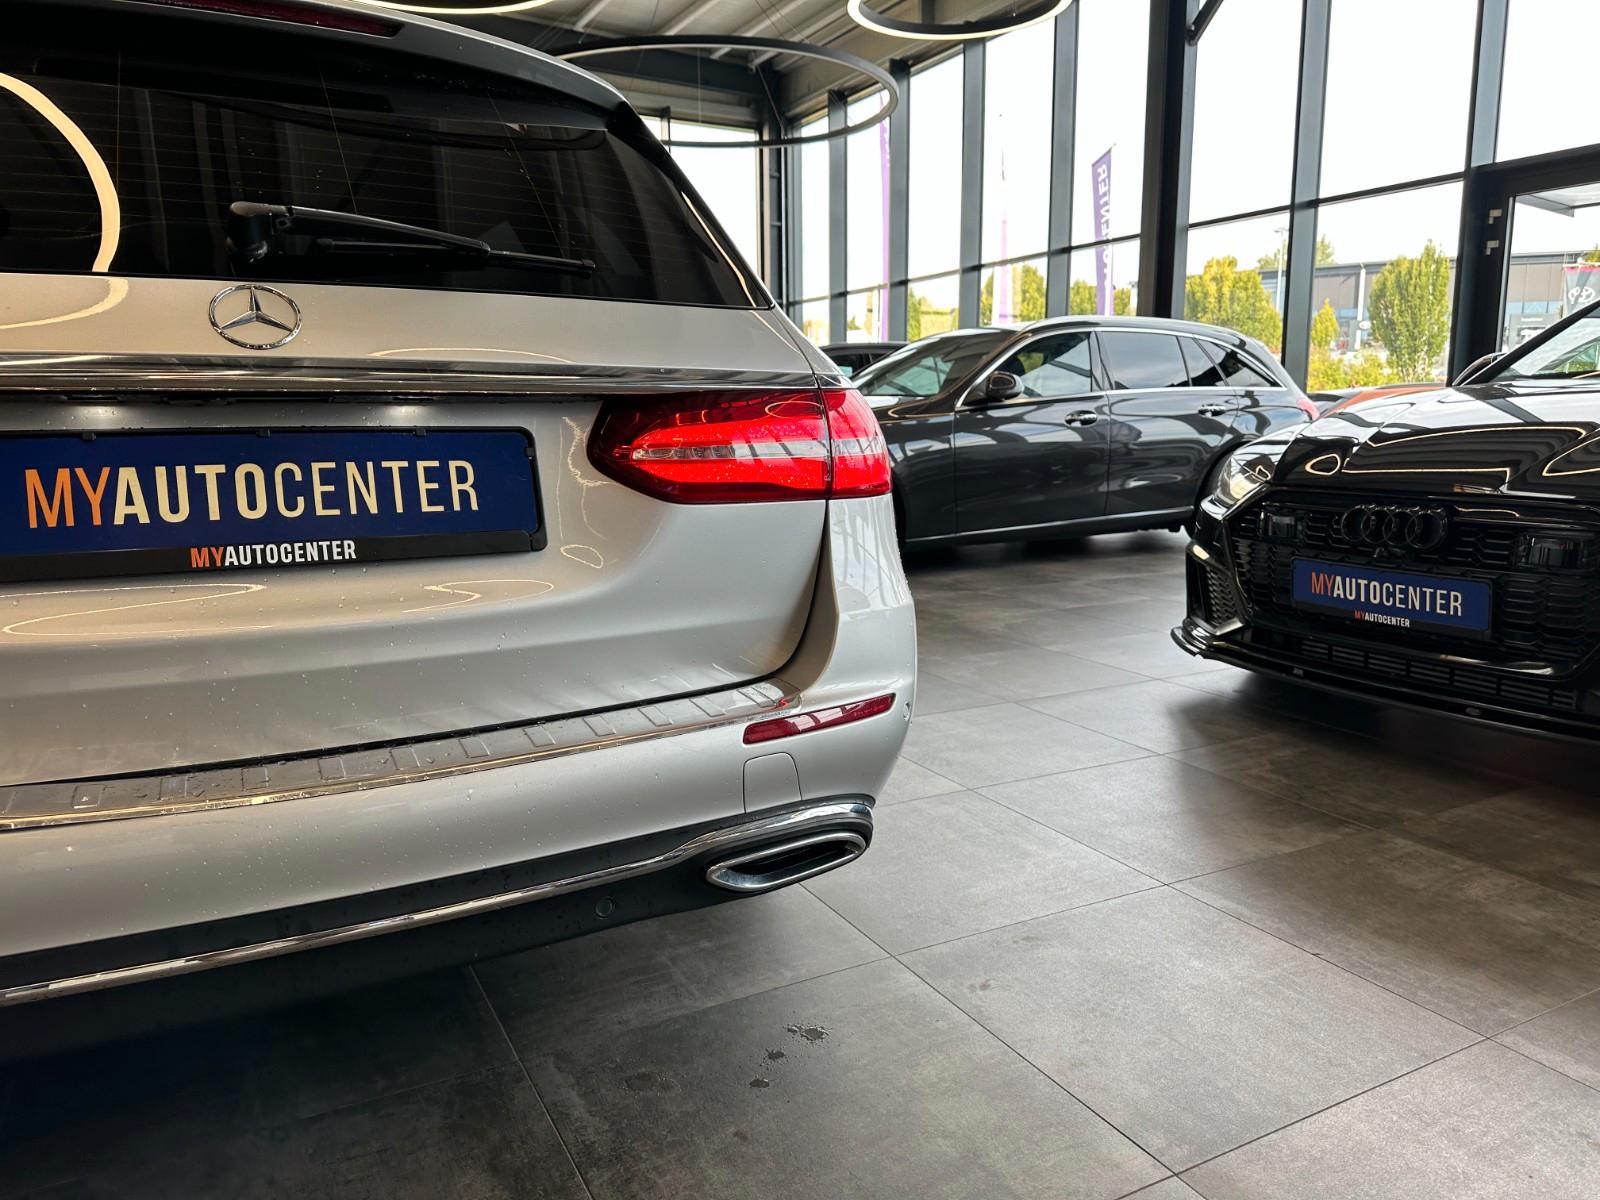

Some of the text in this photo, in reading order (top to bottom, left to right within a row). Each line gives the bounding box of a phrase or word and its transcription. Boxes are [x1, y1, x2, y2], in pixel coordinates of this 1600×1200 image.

[25, 460, 479, 528] MYAUTOCENTER
[191, 540, 357, 568] MYAUTOCENTER
[1311, 571, 1462, 616] MYAUTOCENTER
[1354, 610, 1410, 627] MYAUTOCENTER
